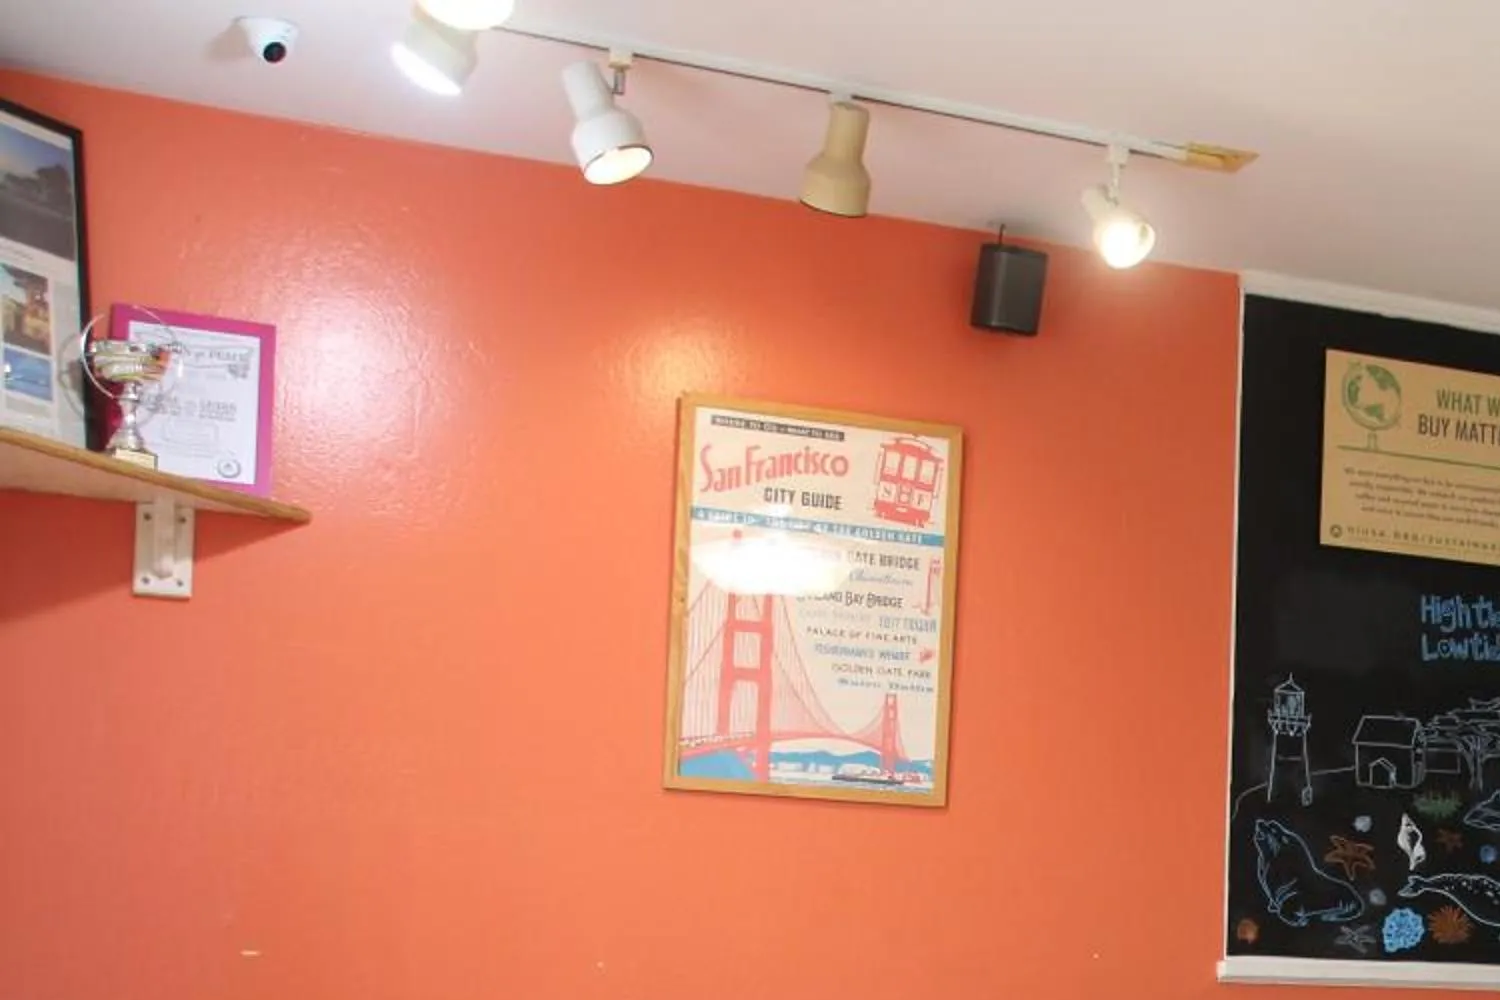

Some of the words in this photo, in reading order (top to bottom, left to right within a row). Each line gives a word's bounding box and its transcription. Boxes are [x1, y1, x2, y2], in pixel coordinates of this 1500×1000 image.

[1436, 388, 1482, 415] WHAT
[1418, 413, 1450, 438] BUY
[700, 442, 741, 493] San
[745, 445, 849, 487] Francisco
[764, 487, 796, 506] CITY
[801, 491, 843, 511] GUIDE
[1420, 594, 1471, 633] High
[1421, 633, 1468, 661] Low
